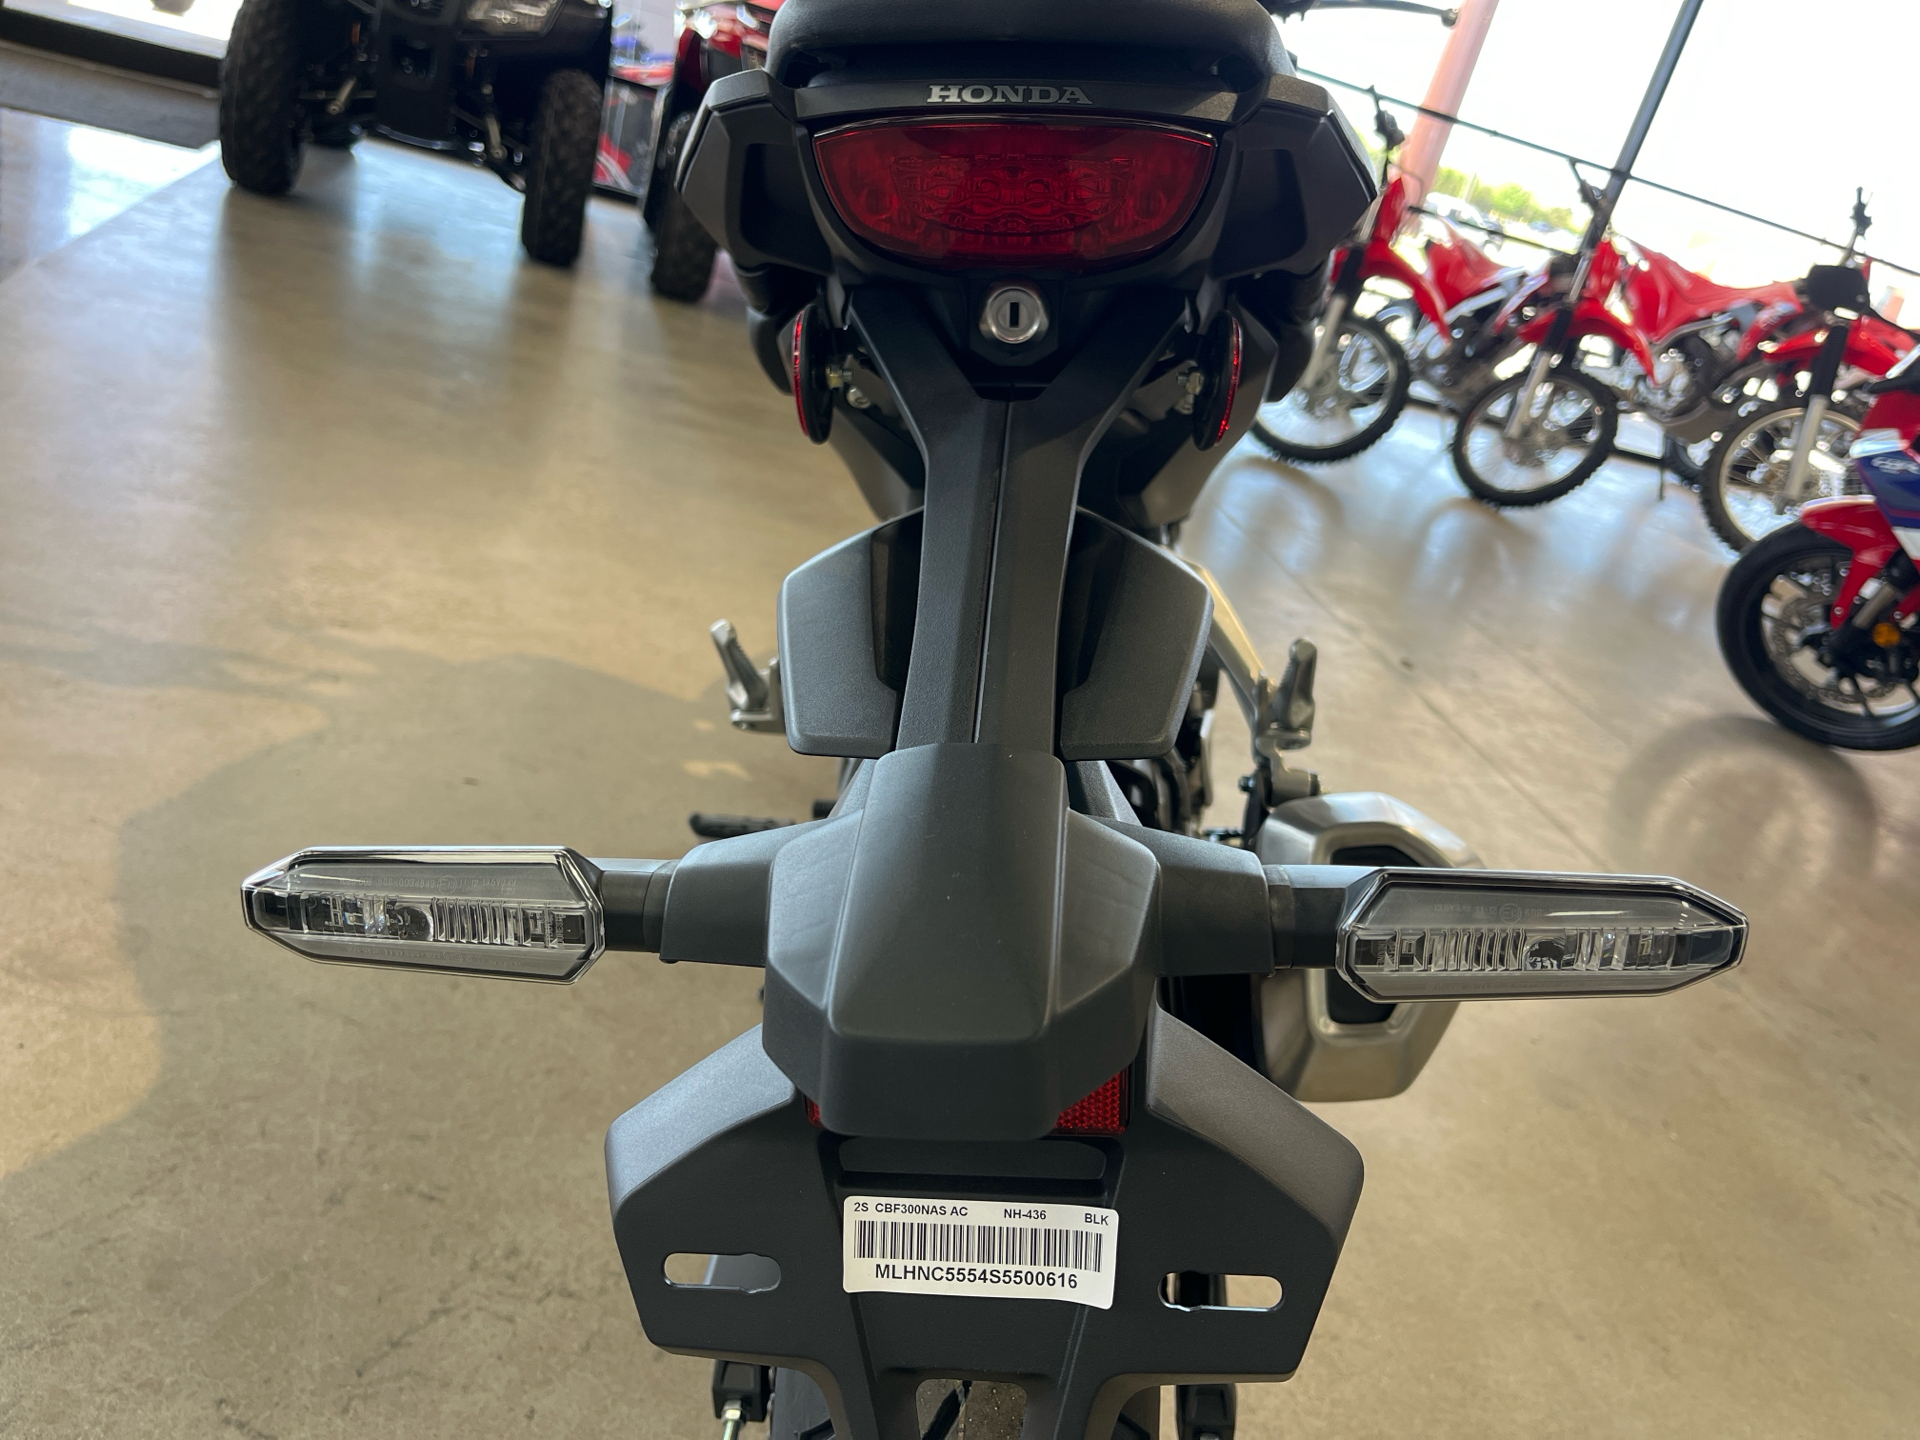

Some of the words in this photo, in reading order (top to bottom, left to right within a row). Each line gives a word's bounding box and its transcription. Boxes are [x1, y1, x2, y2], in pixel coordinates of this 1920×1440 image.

[926, 85, 1093, 105] HONDA
[853, 1202, 869, 1212] 2S
[875, 1203, 947, 1216] CBF300NAS
[950, 1206, 968, 1217] AC
[1003, 1208, 1047, 1220] NH-436
[1084, 1212, 1109, 1226] BLK
[875, 1263, 1078, 1289] MLHNC5554S5500616
